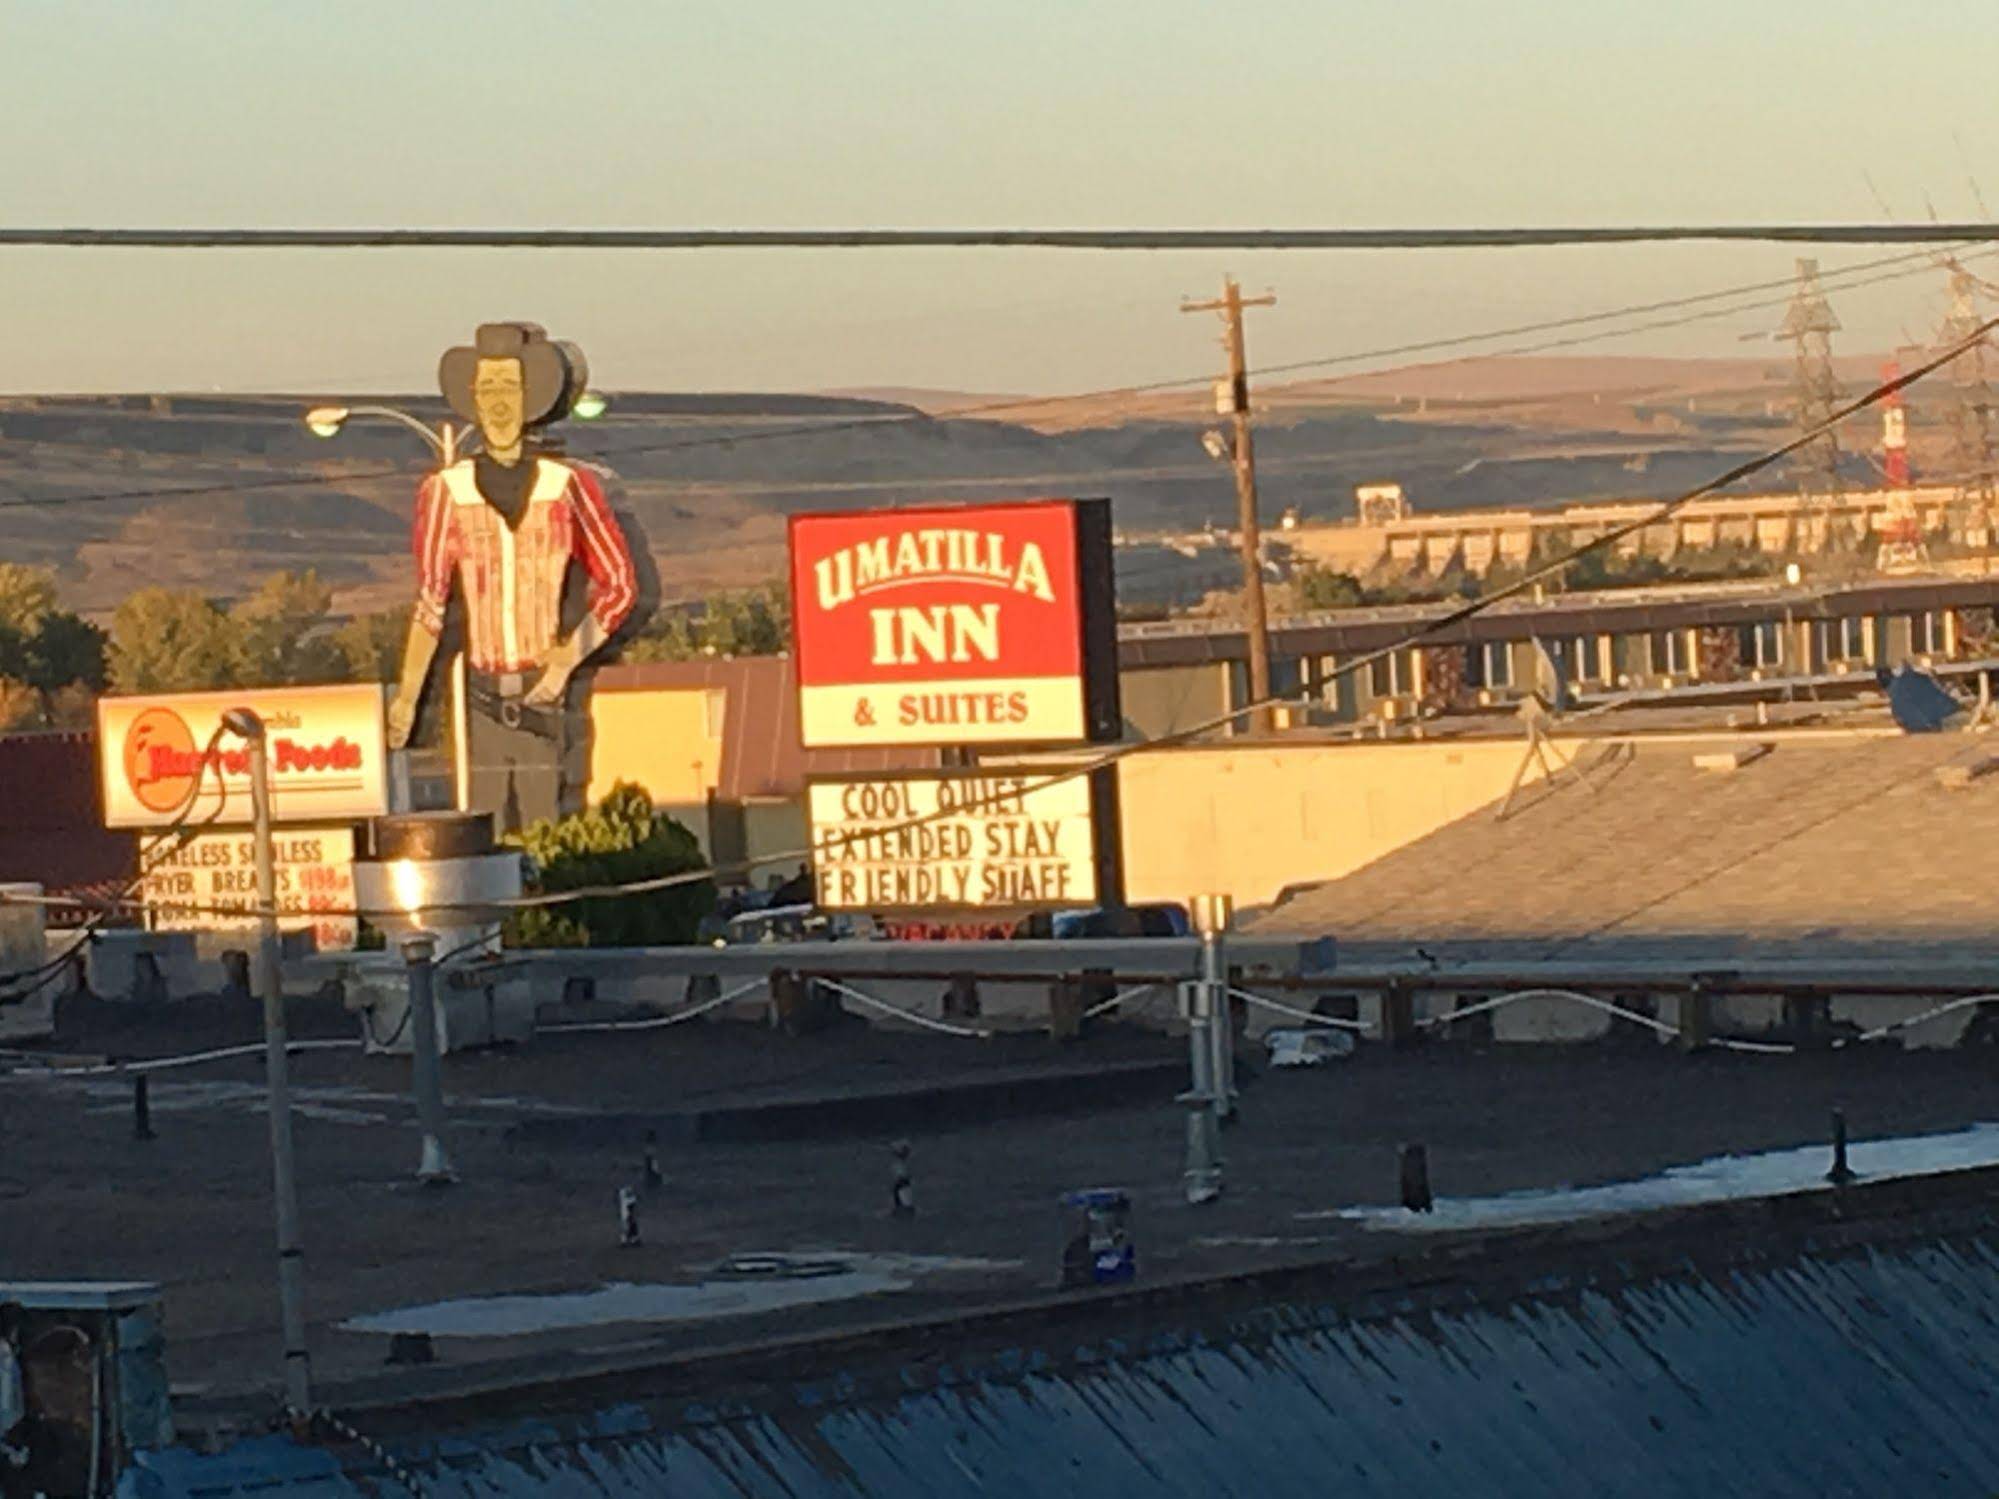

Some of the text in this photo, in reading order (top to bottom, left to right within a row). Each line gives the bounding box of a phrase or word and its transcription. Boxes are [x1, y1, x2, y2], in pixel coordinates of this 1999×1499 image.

[814, 529, 1056, 610] UMATILLA
[870, 603, 1000, 665] INN
[854, 692, 1029, 726] & SUITES
[841, 778, 1028, 820] COOL QUIET
[823, 820, 1061, 864] EXTENDED STAY
[819, 863, 1071, 905] FRIENDLY STAFF
